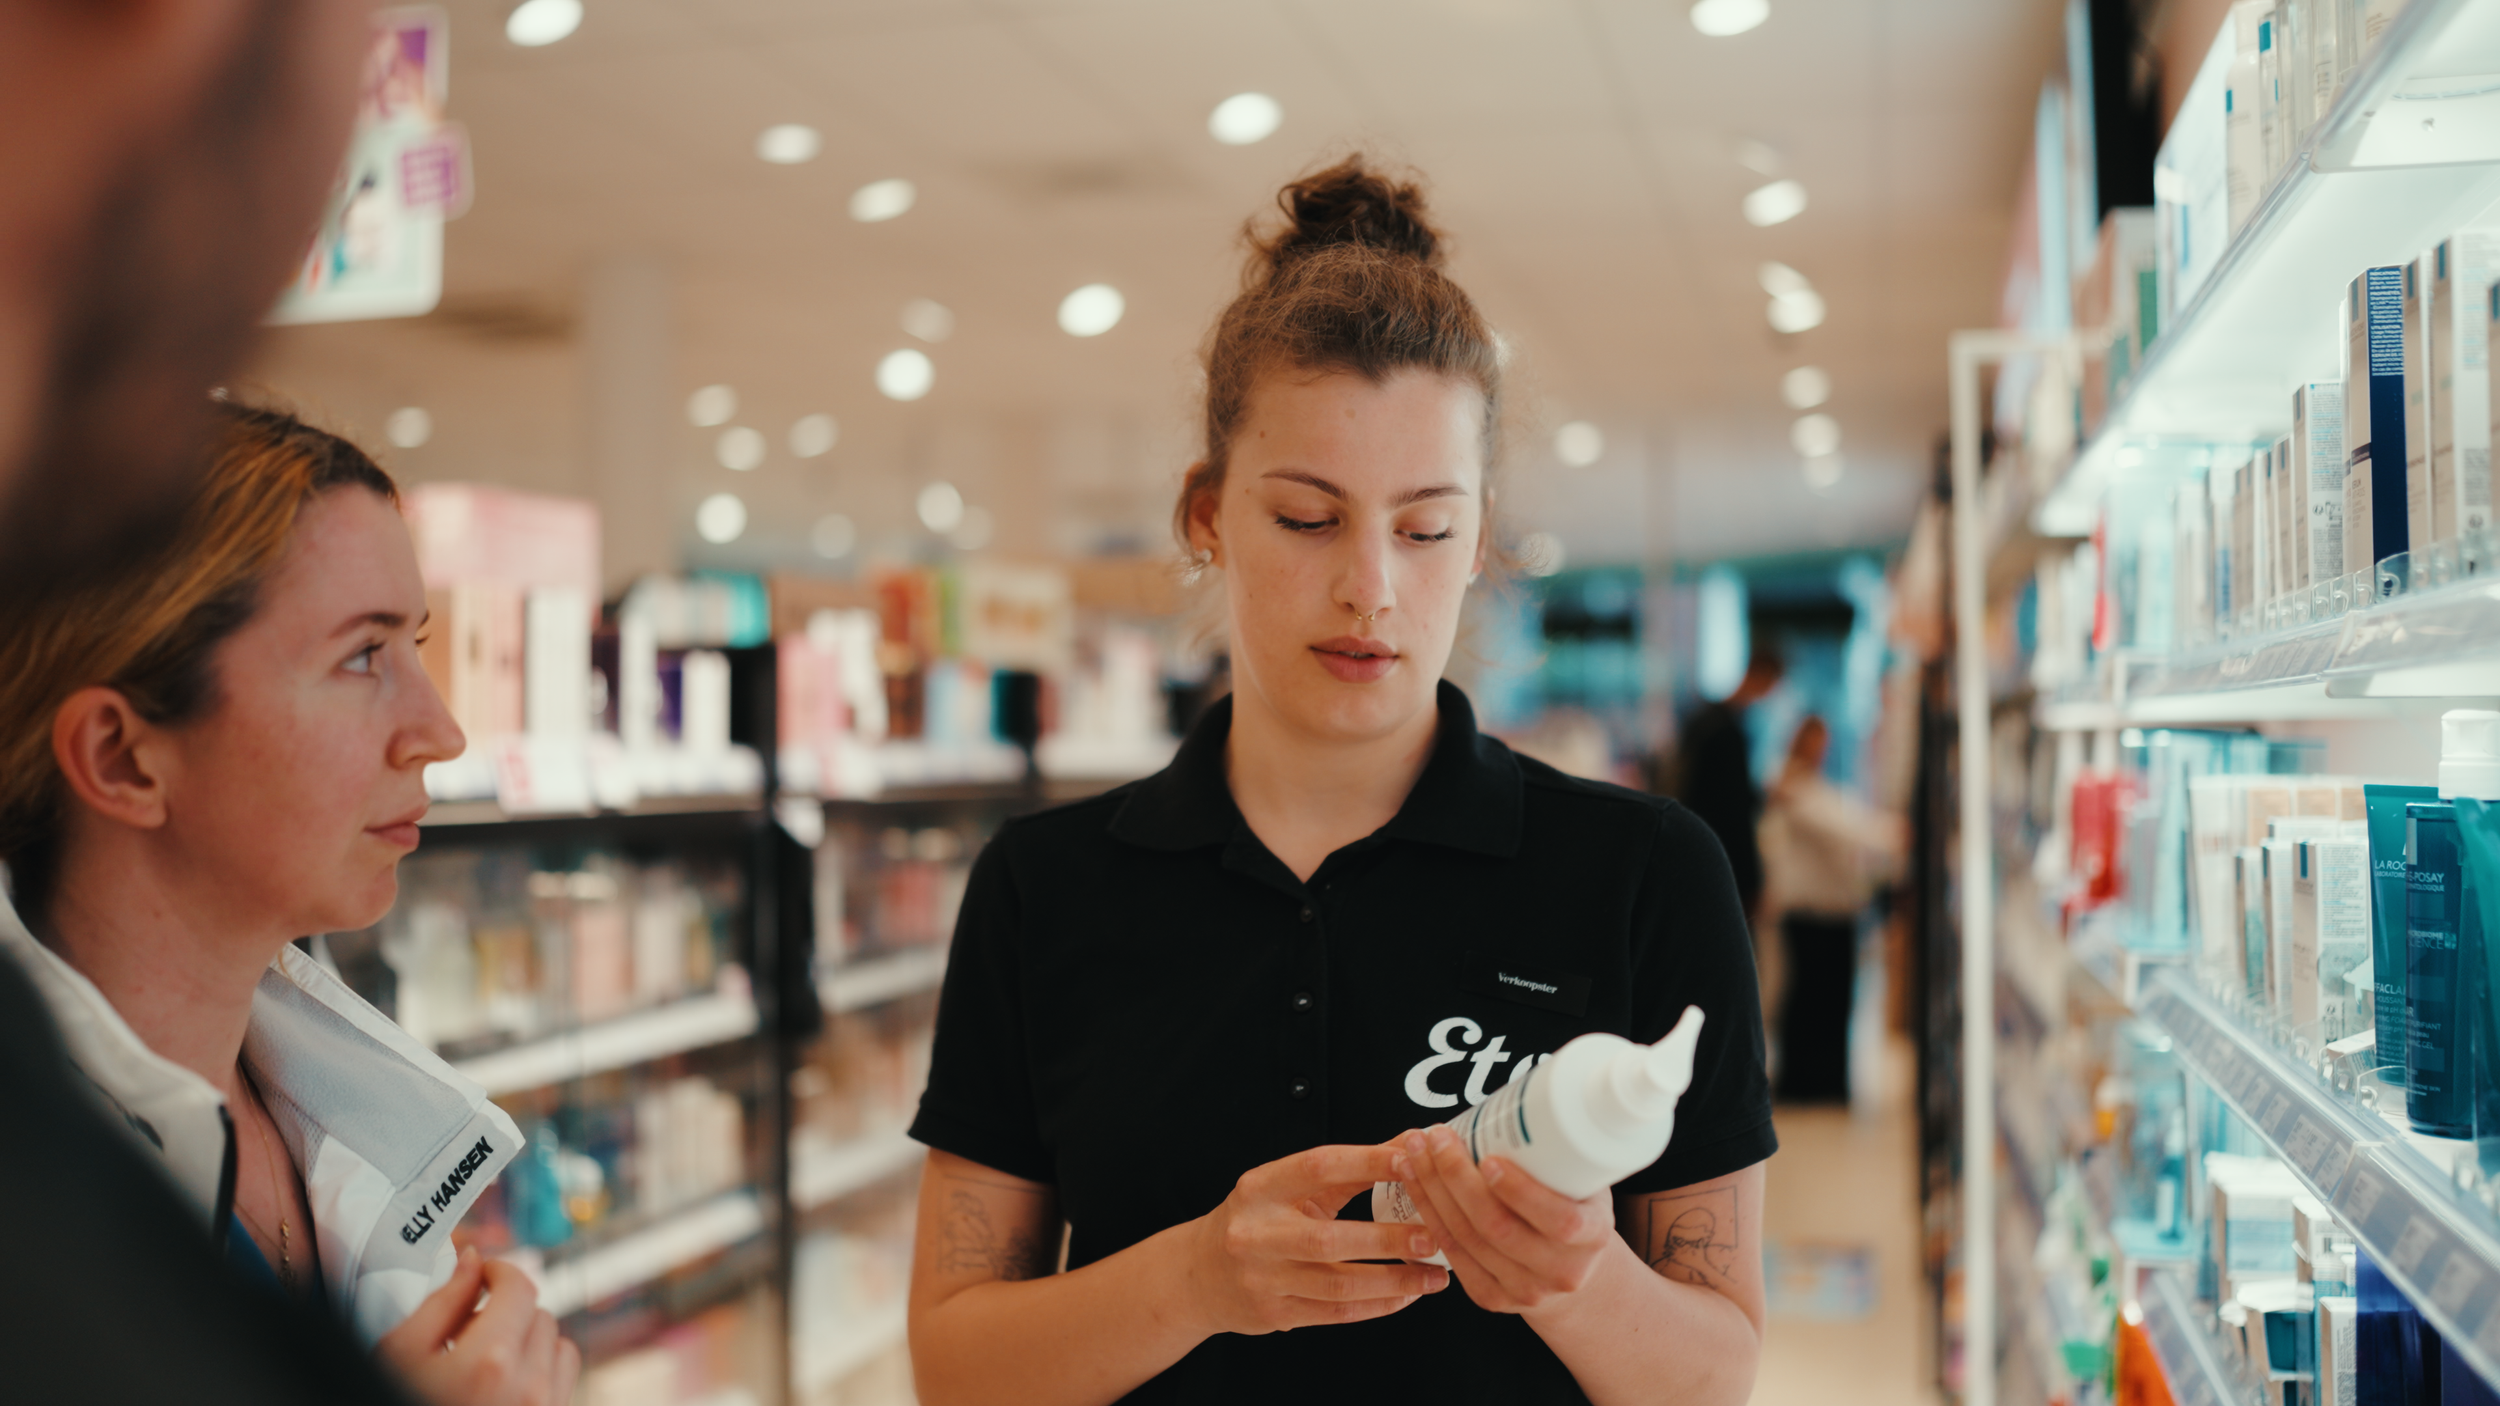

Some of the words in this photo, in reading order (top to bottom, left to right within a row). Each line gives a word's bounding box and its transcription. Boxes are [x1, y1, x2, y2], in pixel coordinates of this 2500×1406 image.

[2374, 860, 2385, 869] LA
[1498, 972, 1558, 994] Verkoopster
[1404, 1016, 1552, 1109] Et
[399, 1204, 436, 1245] ELLY
[430, 1135, 494, 1213] HANSEN
[1395, 1181, 1409, 1220] 00ml
